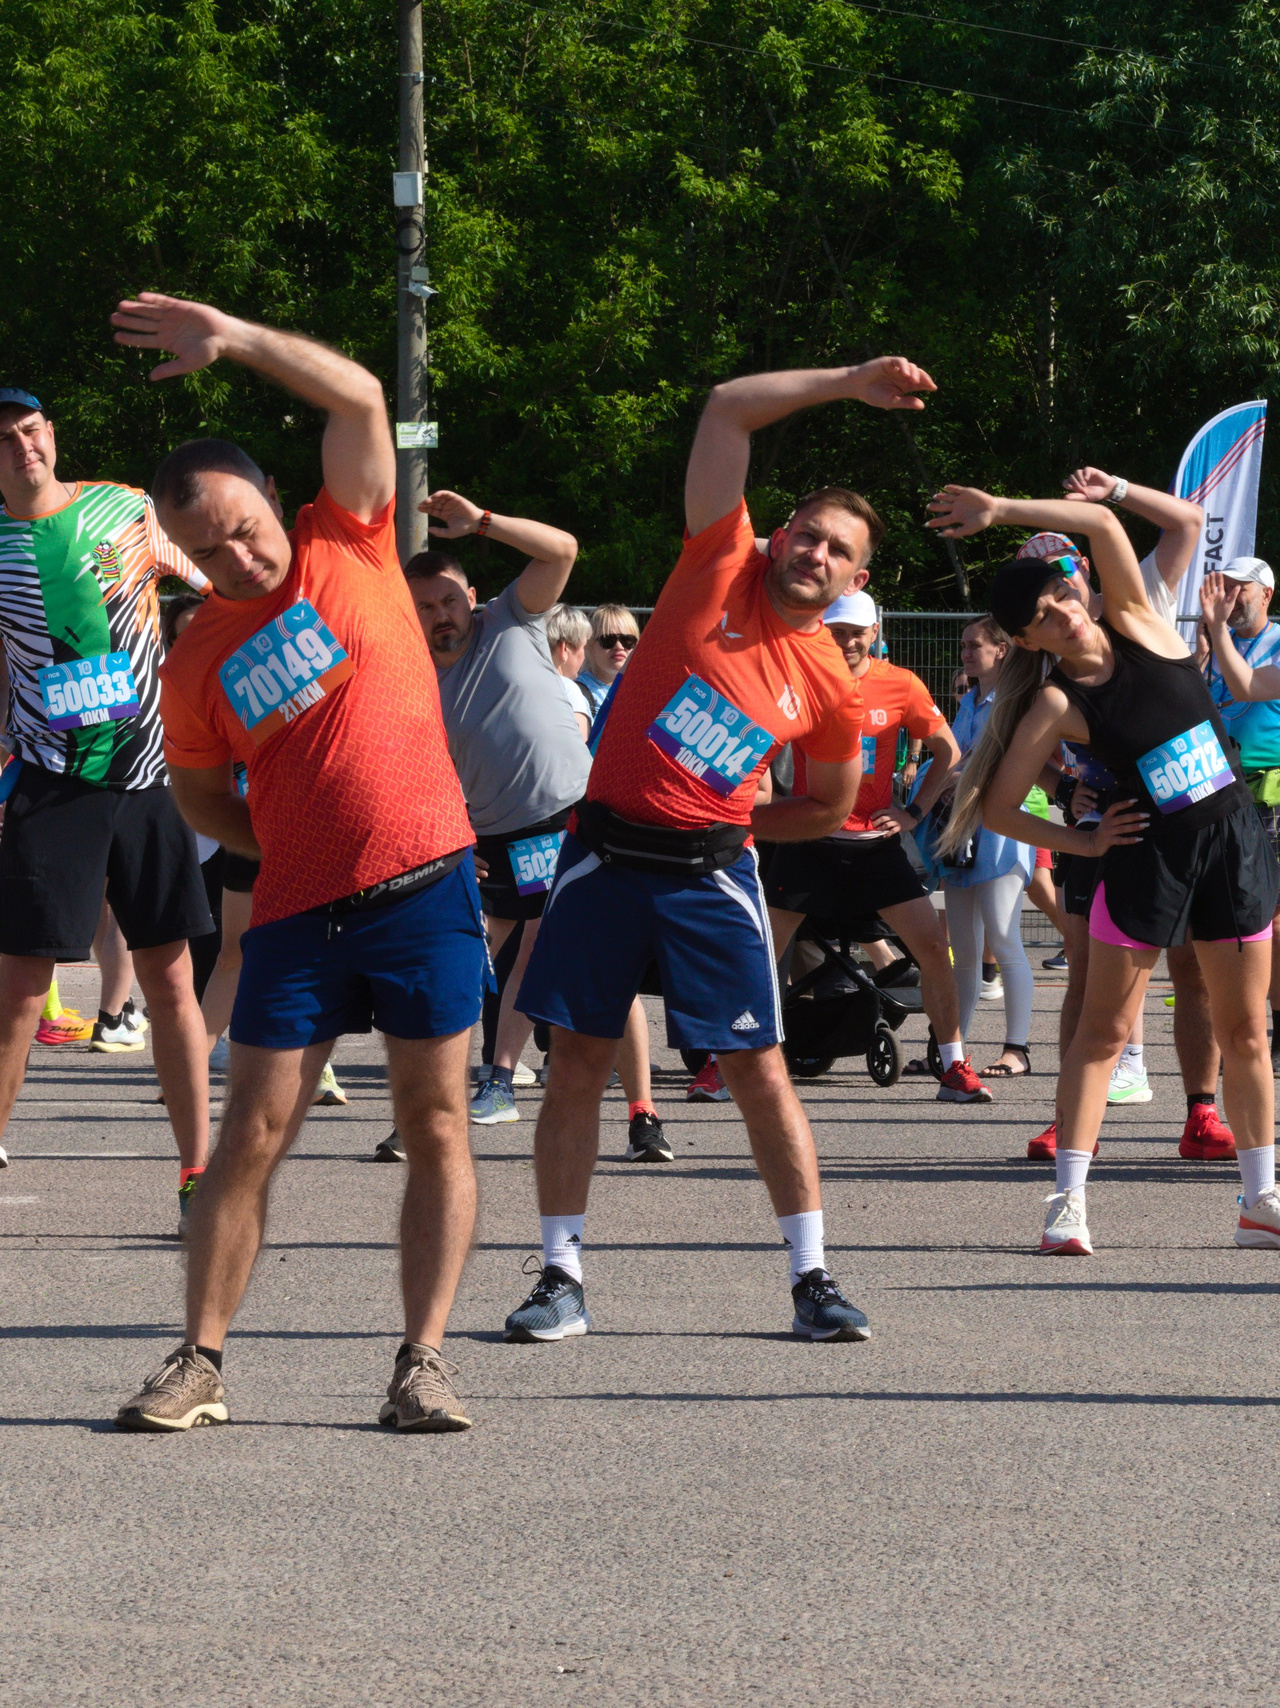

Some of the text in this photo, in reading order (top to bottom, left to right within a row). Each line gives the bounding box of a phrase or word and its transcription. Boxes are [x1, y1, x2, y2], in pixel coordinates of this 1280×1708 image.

[233, 628, 333, 718] 70149
[46, 670, 131, 716] 50033
[79, 707, 110, 726] 10KM
[665, 696, 753, 778] 50014
[674, 746, 709, 778] 10KM
[1148, 741, 1225, 800] 50272
[1187, 781, 1216, 804] 10KM
[388, 860, 445, 891] DEMIX
[731, 1021, 760, 1030] adidas
